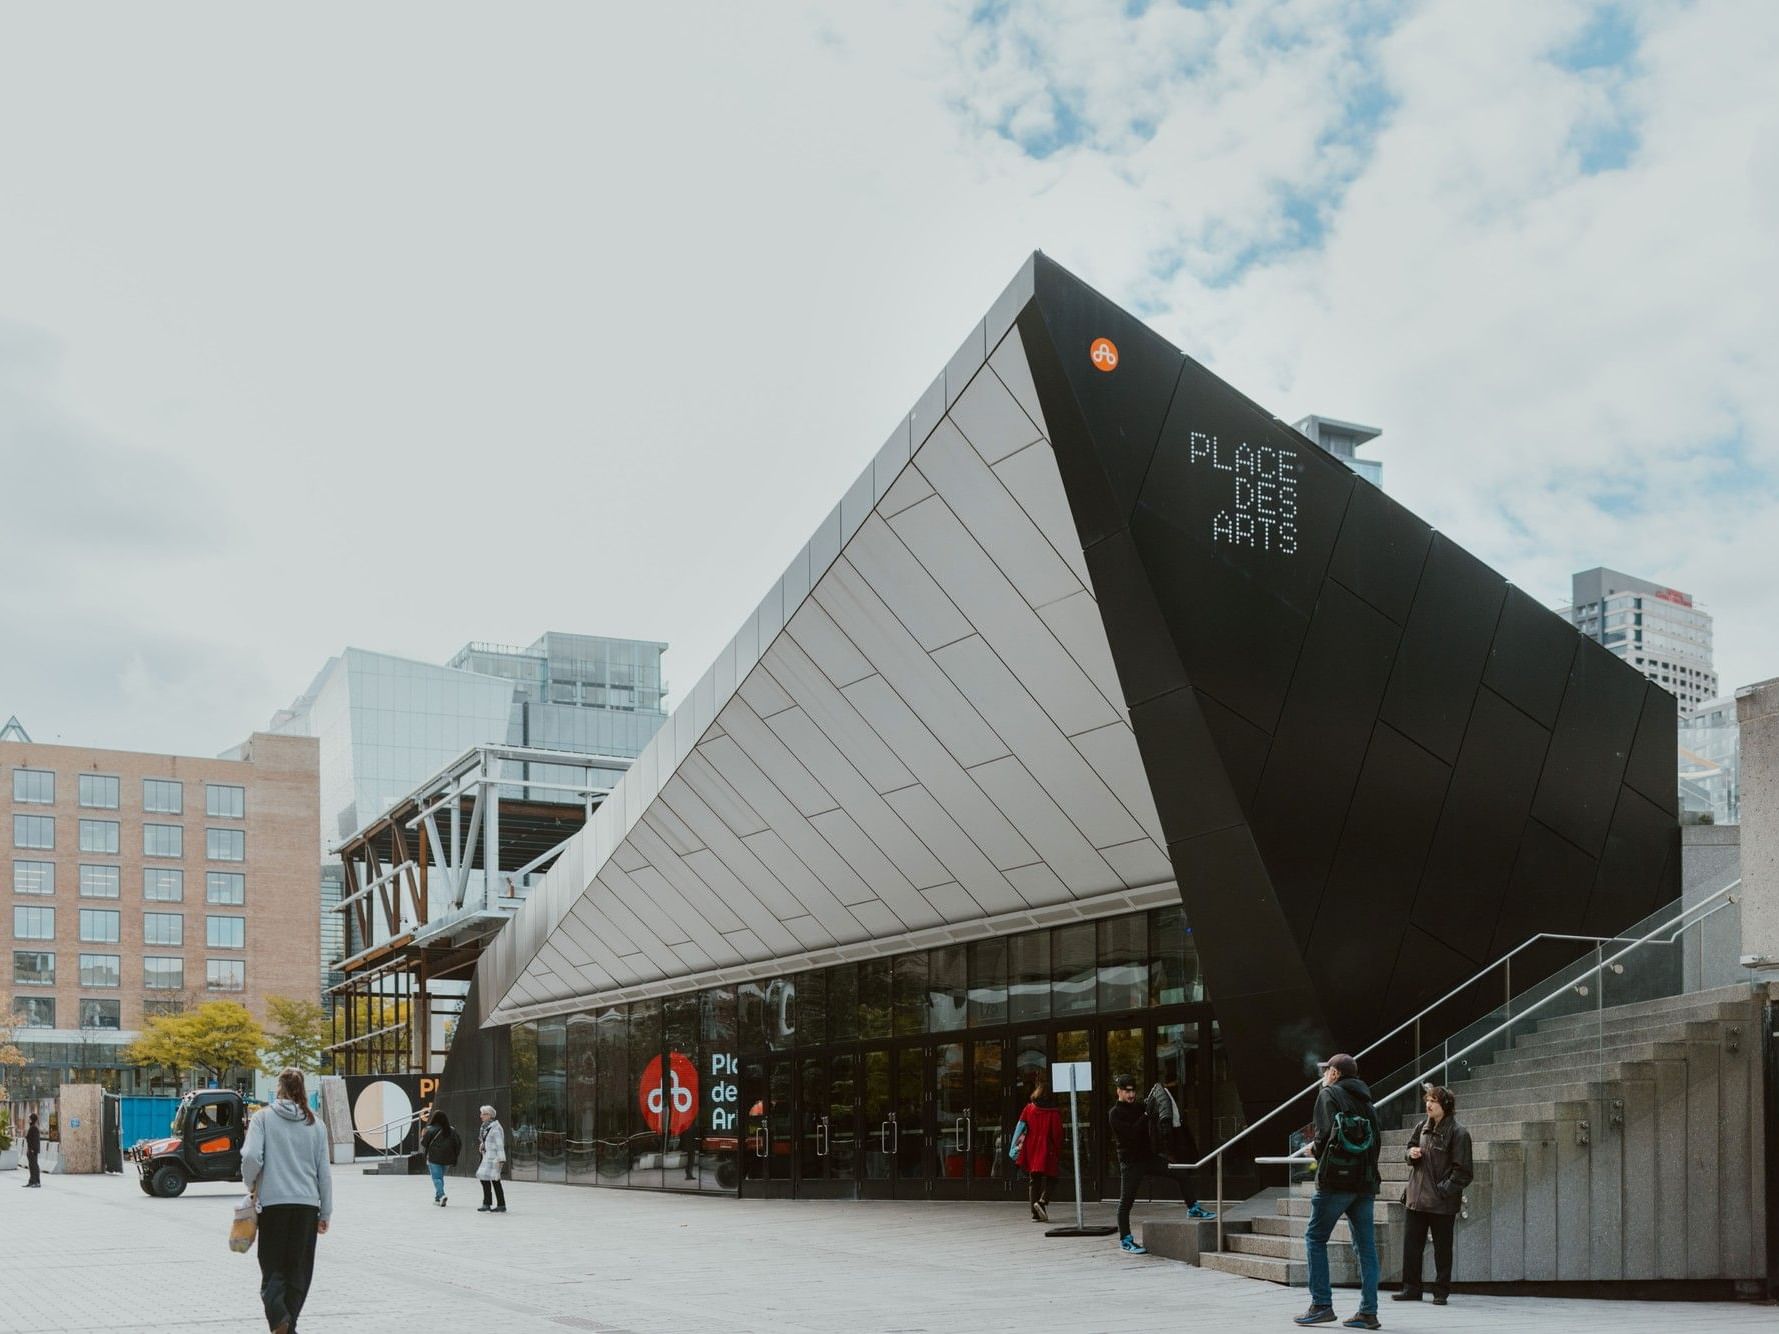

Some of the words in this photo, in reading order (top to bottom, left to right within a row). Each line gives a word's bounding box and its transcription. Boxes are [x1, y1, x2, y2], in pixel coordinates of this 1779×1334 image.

[1190, 431, 1297, 484] PLACE
[1236, 477, 1297, 519] DES
[1213, 510, 1297, 554] ARTS
